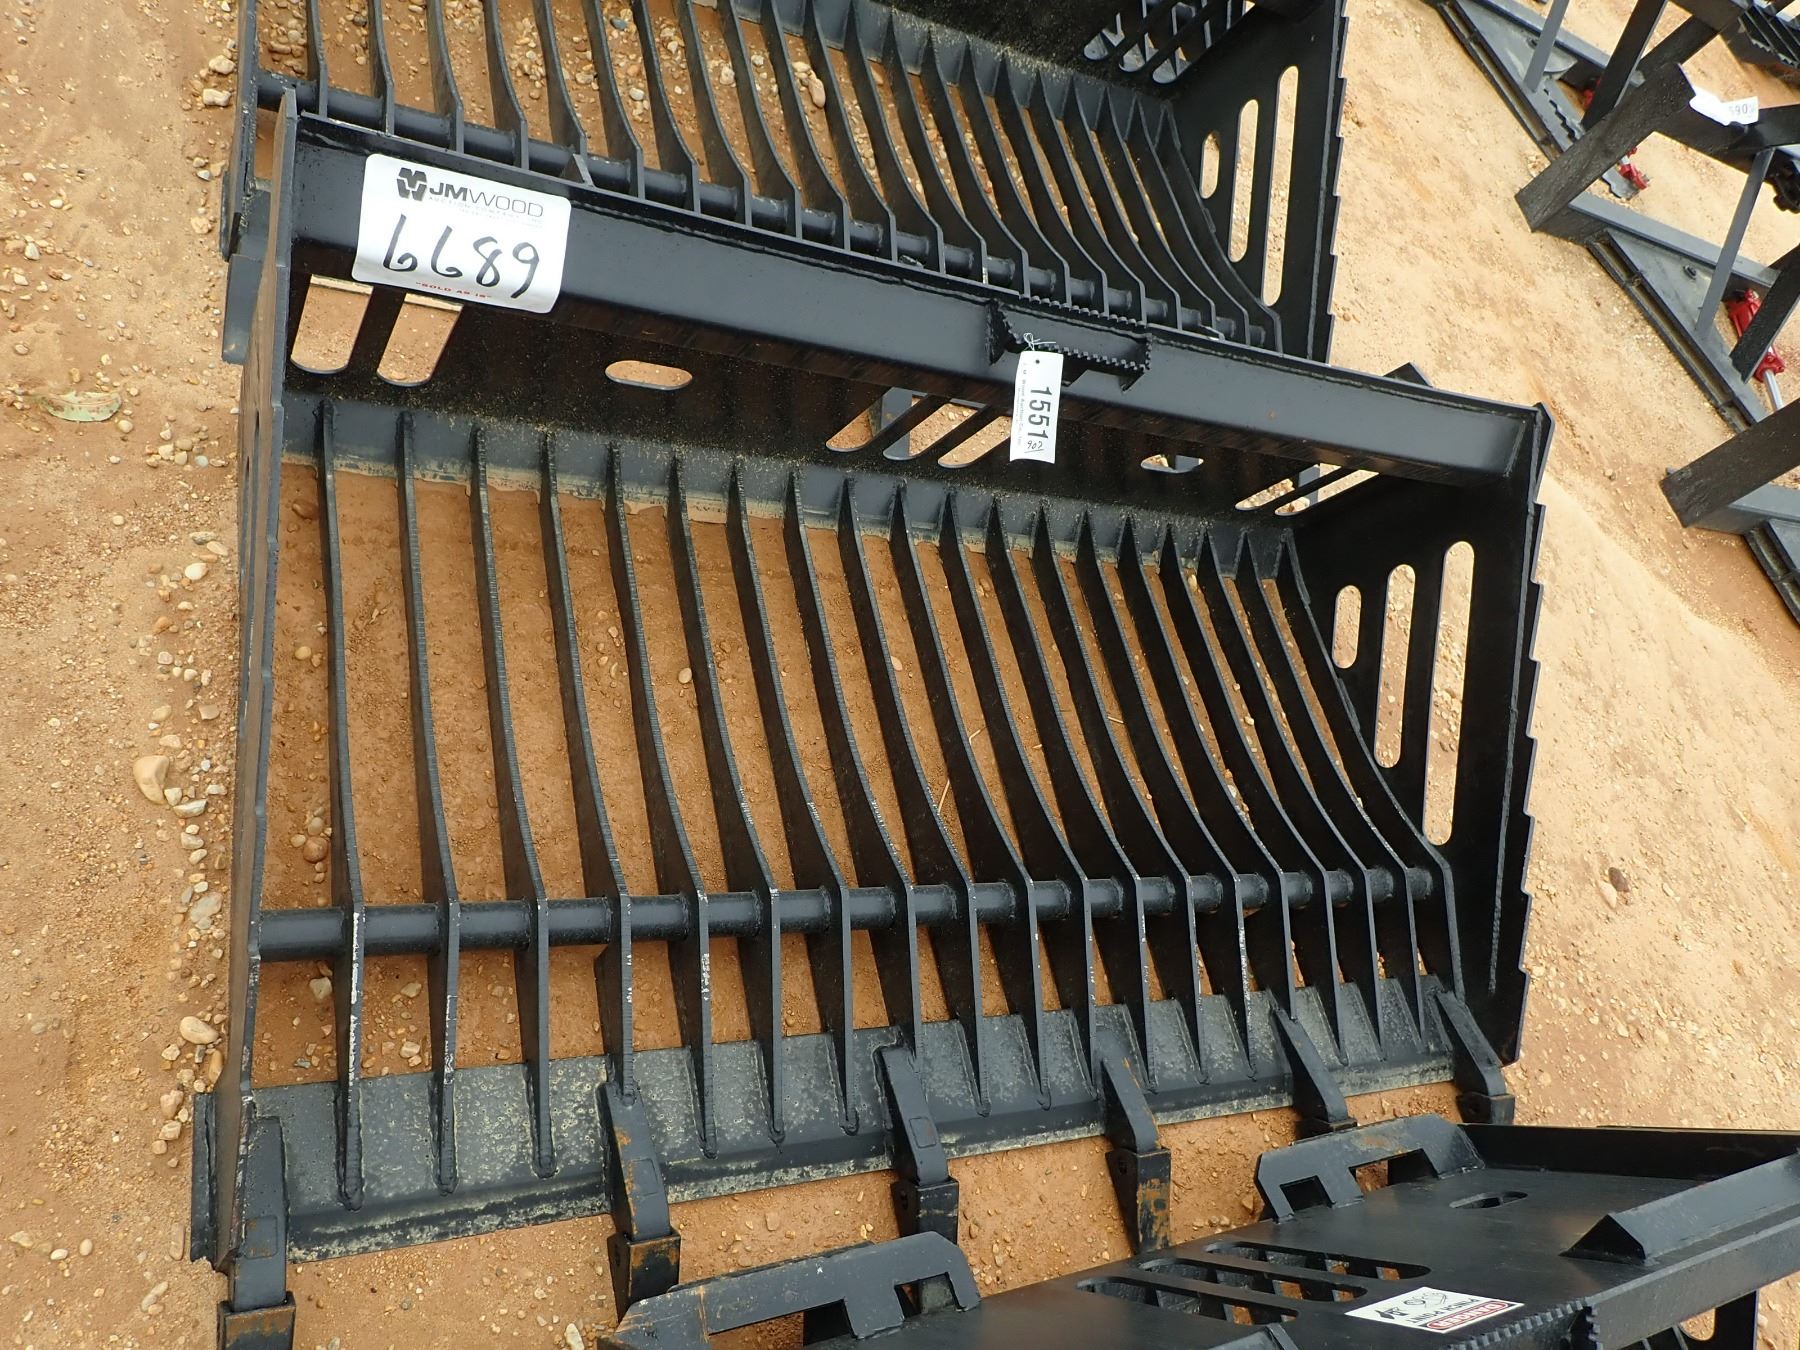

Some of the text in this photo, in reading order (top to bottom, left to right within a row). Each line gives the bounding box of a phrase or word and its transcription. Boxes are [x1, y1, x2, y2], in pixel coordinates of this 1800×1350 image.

[382, 213, 540, 299] 6689
[1028, 386, 1053, 439] 1551
[1407, 1310, 1445, 1323] POINT
[1432, 1303, 1502, 1327] DANGER
